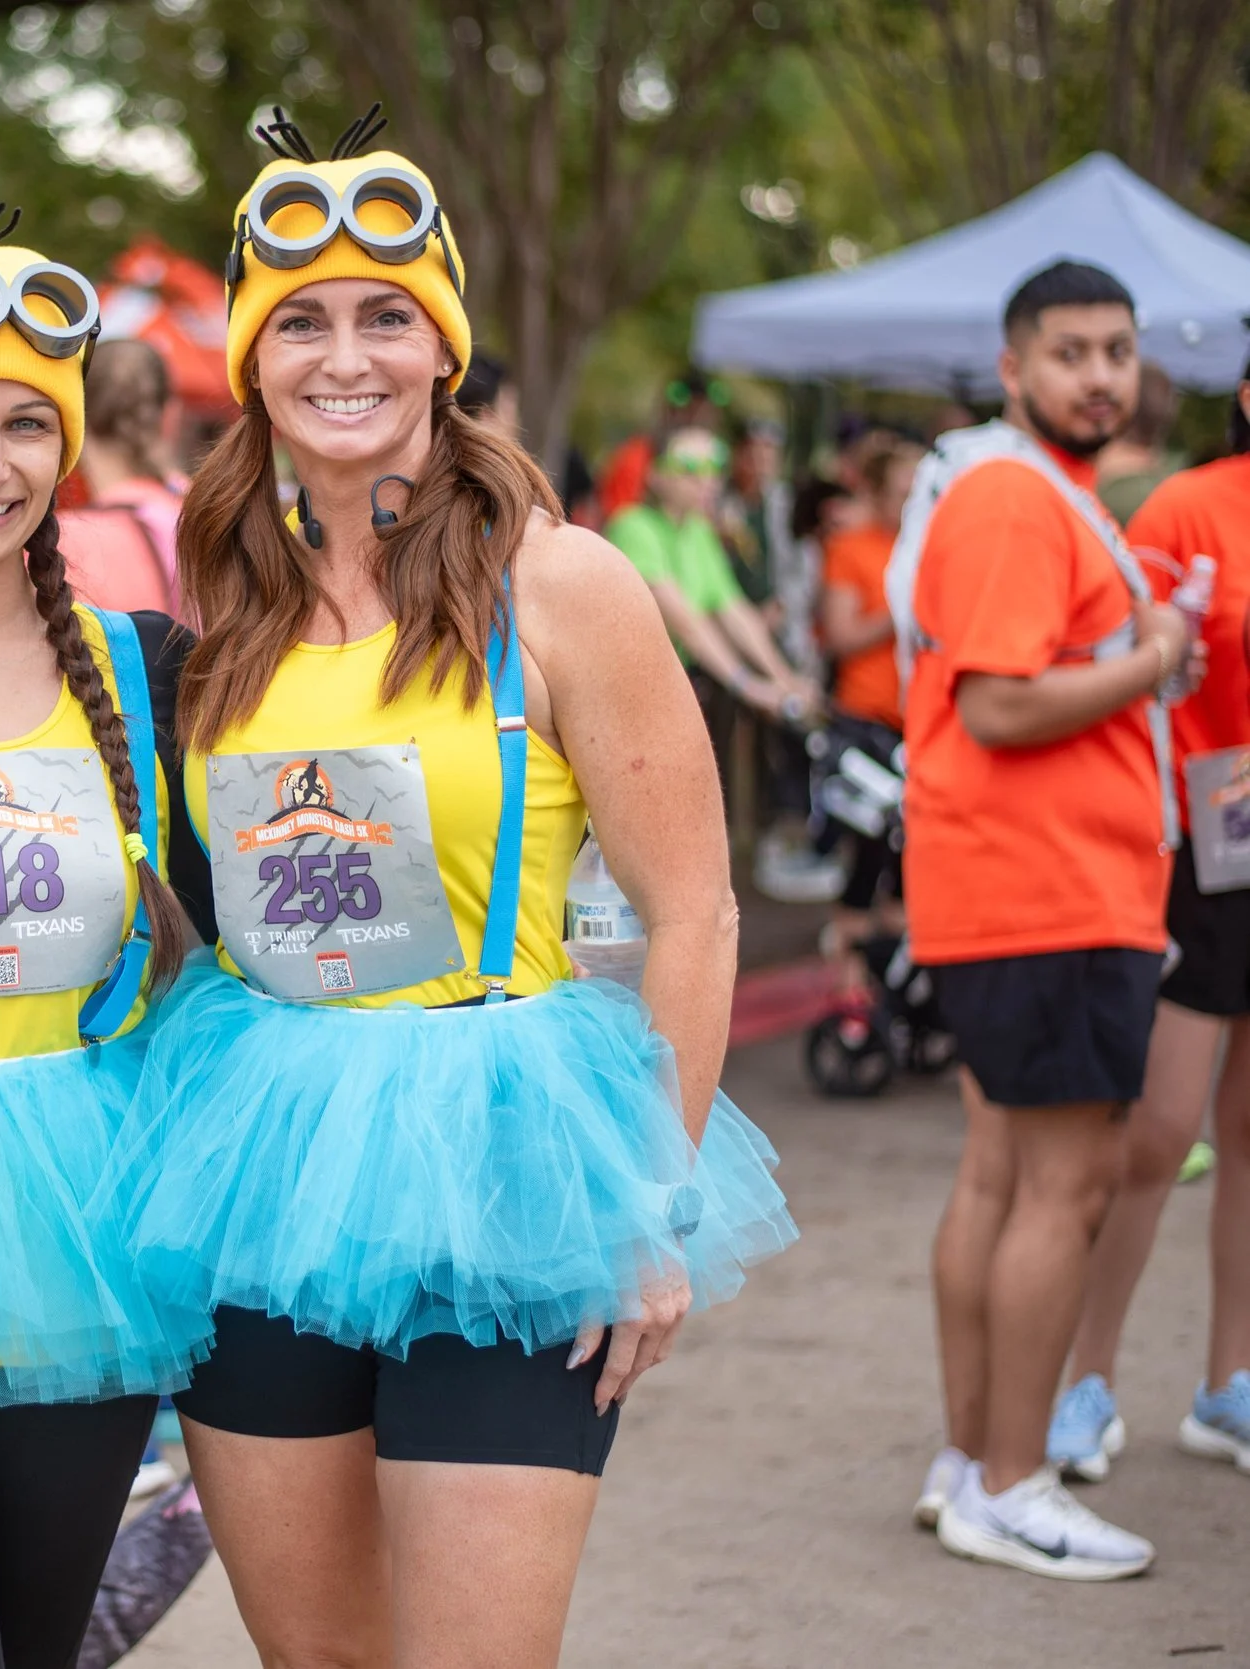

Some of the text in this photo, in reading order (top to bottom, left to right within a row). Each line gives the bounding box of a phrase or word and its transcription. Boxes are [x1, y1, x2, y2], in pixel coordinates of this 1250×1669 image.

[256, 812, 369, 842] MCKINNEY MONSTER DASH 5K
[258, 852, 382, 925] 255
[10, 916, 85, 940] TEXANS
[267, 929, 317, 942] TRINITY
[336, 922, 411, 945] TEXANS
[270, 942, 308, 954] FALLS
